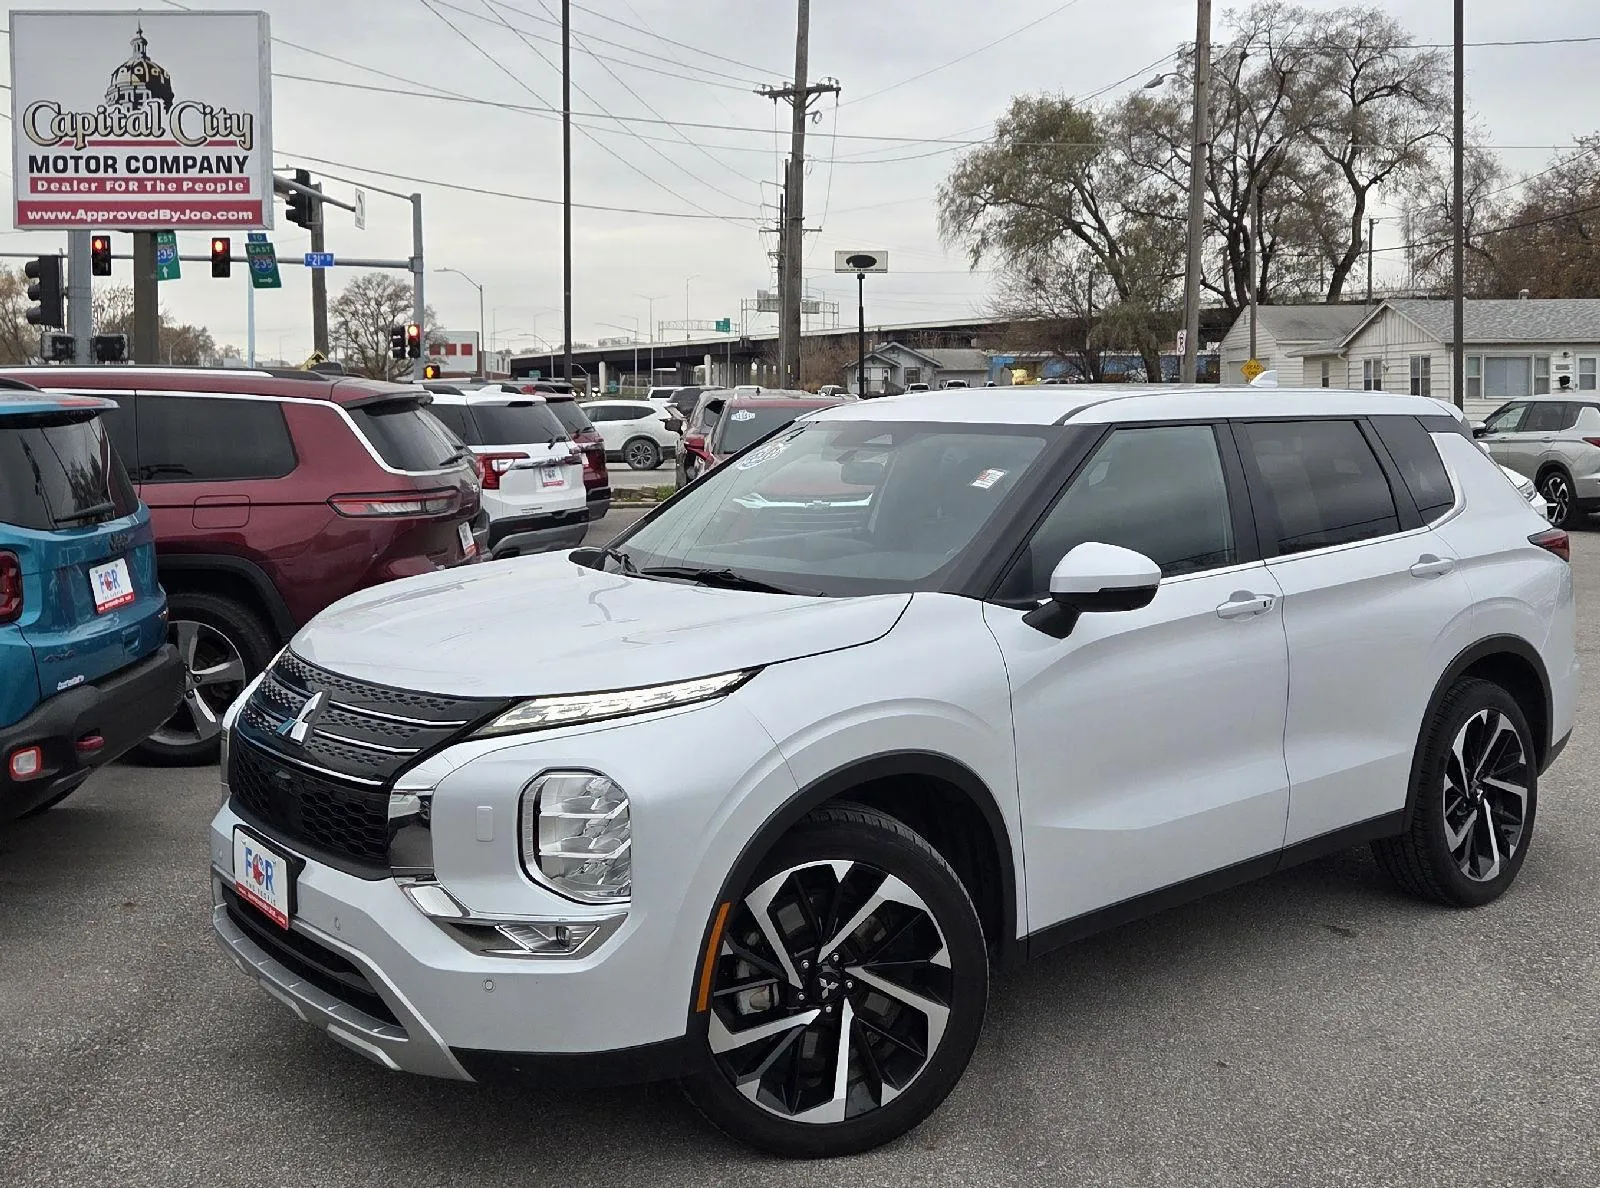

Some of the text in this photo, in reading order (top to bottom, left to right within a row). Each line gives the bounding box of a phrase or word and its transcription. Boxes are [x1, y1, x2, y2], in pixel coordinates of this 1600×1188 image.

[23, 100, 254, 151] Capital City
[29, 155, 249, 174] MOTOR COMPANY
[37, 180, 98, 192] Dealer
[105, 181, 139, 192] FOR
[144, 180, 177, 192] The
[27, 209, 253, 222] www.ApprovedByJoe.com
[157, 235, 173, 243] EST
[254, 259, 273, 269] 235
[245, 847, 276, 896] FOR
